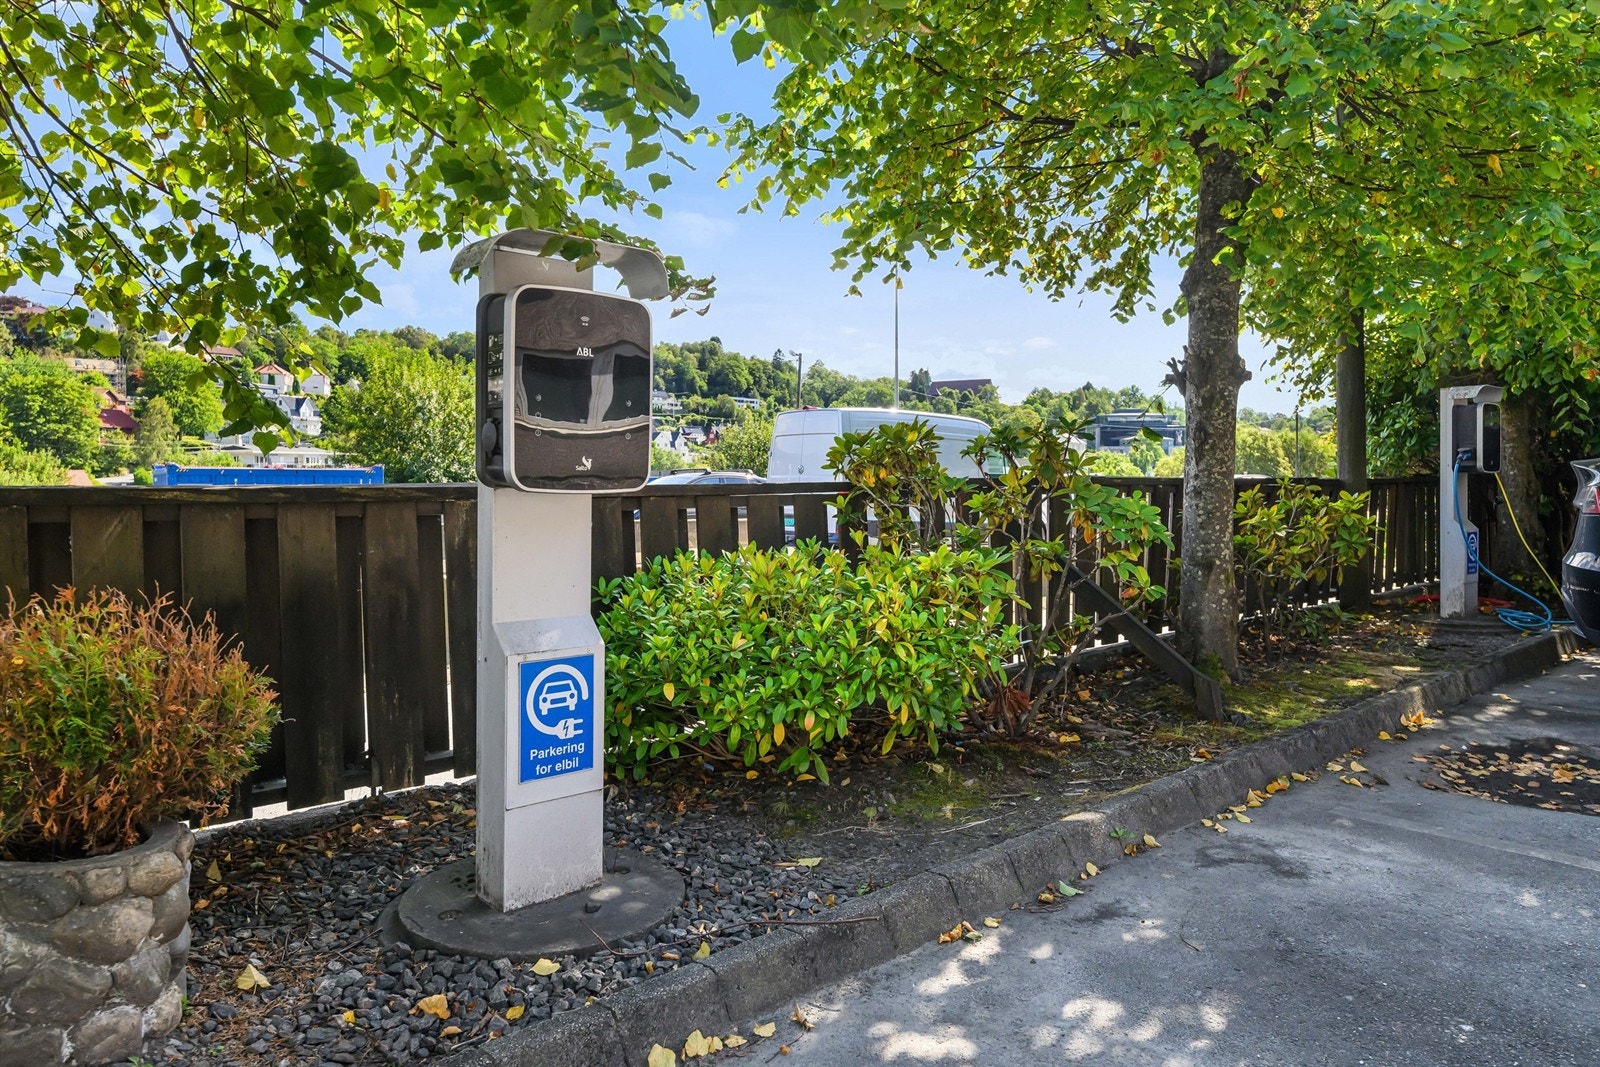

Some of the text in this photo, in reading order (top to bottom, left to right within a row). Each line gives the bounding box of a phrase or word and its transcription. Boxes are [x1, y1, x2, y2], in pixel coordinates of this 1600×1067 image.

[576, 346, 594, 357] ABL
[530, 742, 585, 761] Parkering
[535, 757, 579, 776] for elbil
